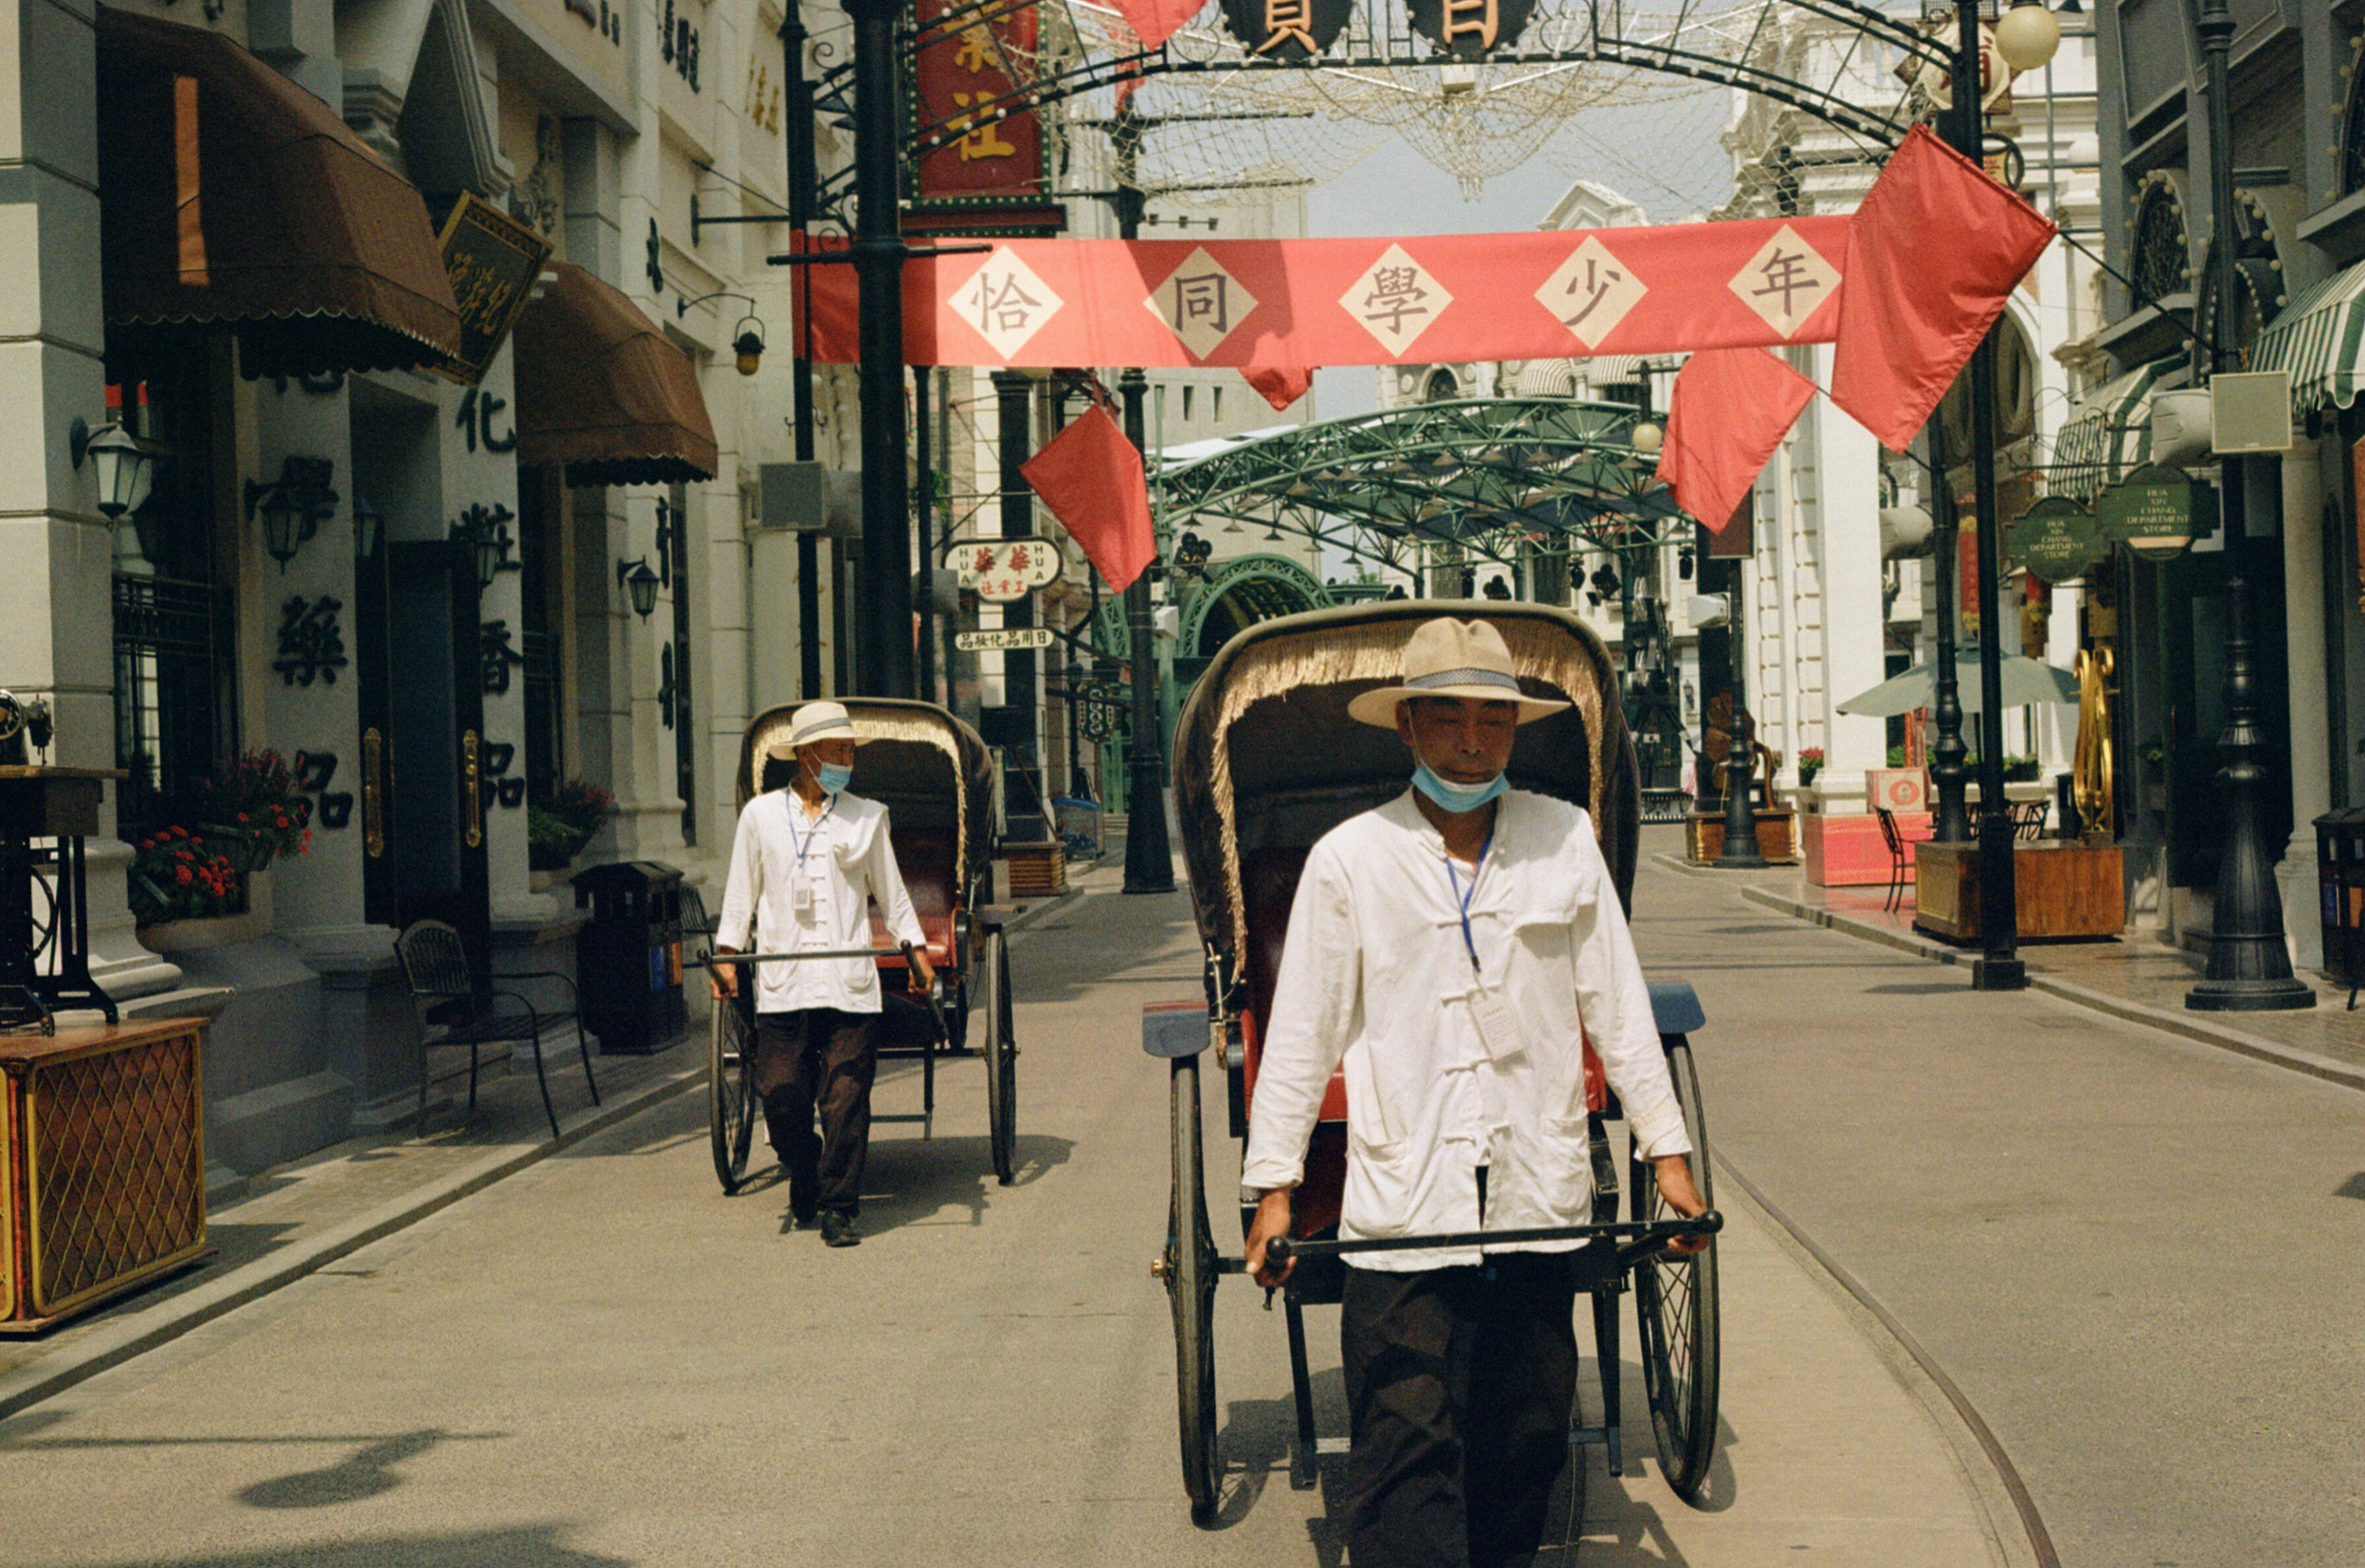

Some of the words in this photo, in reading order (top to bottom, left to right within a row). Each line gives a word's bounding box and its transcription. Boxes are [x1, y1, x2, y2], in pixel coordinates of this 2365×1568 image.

[971, 247, 1820, 335] 恰同學少年
[2127, 515, 2189, 524] DEPARTMENT
[2143, 525, 2172, 533] STORE
[959, 548, 971, 585] HUA
[1034, 544, 1045, 581] HUA
